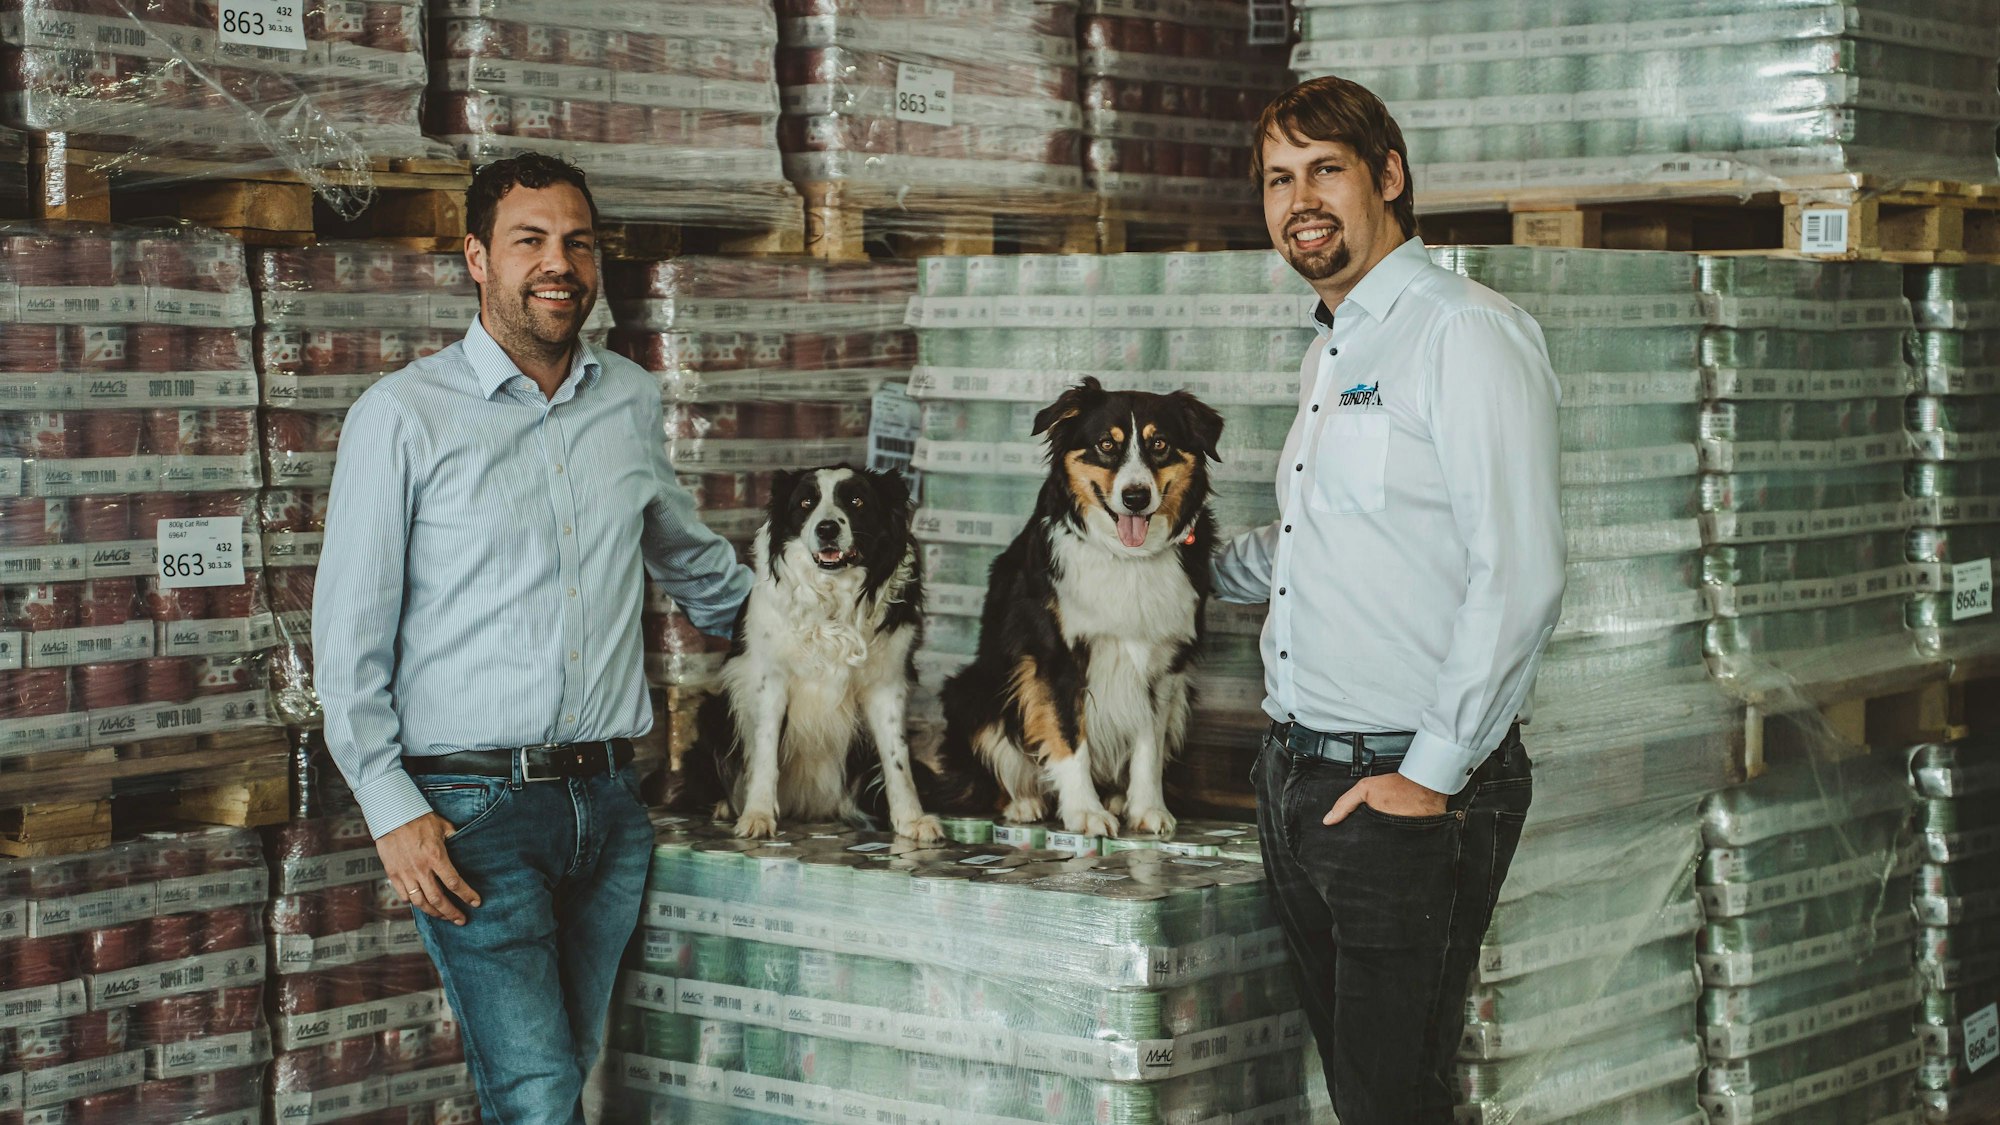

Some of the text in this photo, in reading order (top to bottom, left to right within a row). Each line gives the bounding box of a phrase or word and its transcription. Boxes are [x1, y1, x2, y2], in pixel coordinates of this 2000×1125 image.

[276, 7, 292, 16] 432
[223, 9, 264, 35] 863
[268, 24, 292, 32] 30.3.26
[98, 25, 121, 44] SUPER
[124, 28, 145, 46] FOOD
[899, 92, 927, 113] 863
[84, 299, 99, 311] FOOD
[90, 380, 194, 397] MAC's SUPER FOOD
[1339, 381, 1383, 406] TUNDRA
[216, 543, 232, 551] 432
[93, 550, 130, 561] MAC's
[4, 558, 41, 572] SUPER FOOD
[163, 553, 204, 577] 863
[1957, 589, 1976, 610] 868
[41, 642, 68, 652] MAC's
[96, 638, 111, 650] FOOD
[98, 708, 201, 731] MAC's SUPER FOOD
[43, 910, 70, 921] MAC's
[659, 905, 672, 917] SUPER
[104, 966, 204, 995] MAC's SUPER FOOD
[4, 1000, 42, 1016] SUPER FOOD
[1146, 1049, 1173, 1062] MAC
[1969, 1037, 1985, 1063] 868
